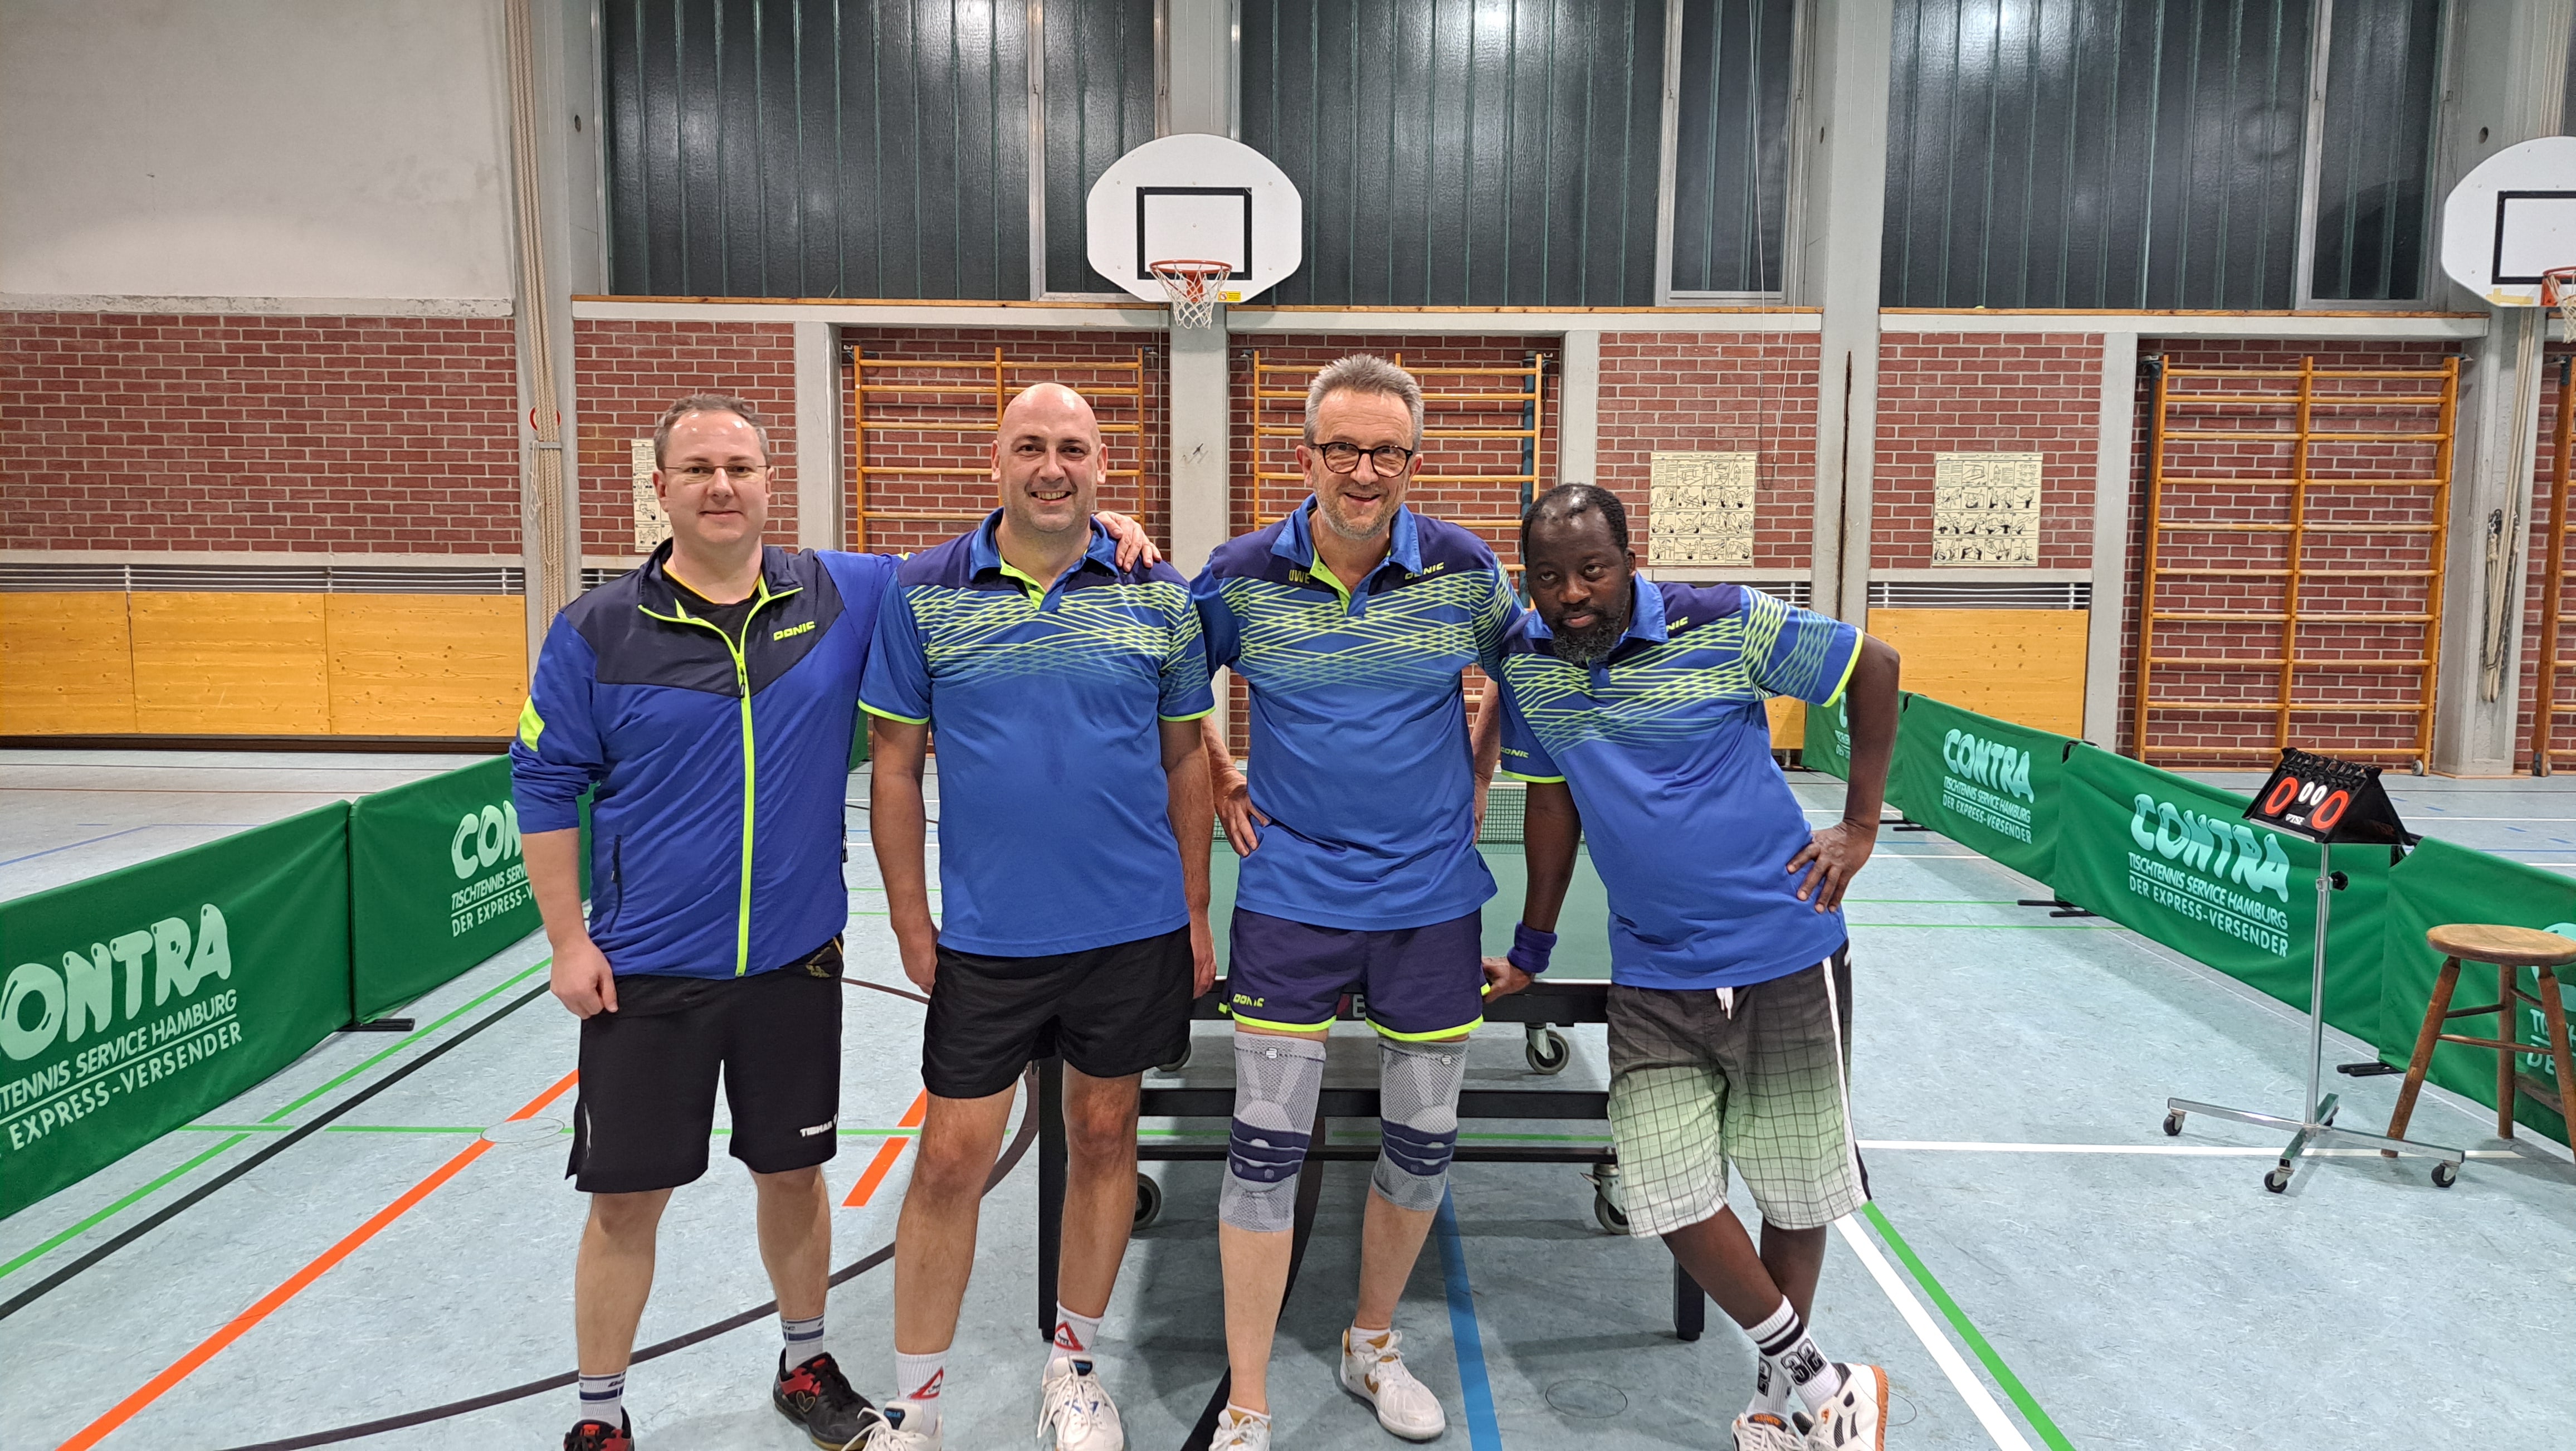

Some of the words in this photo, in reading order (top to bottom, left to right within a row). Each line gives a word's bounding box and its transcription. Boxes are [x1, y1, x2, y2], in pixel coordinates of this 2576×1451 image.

[1289, 569, 1310, 584] UWE
[773, 621, 815, 641] DONIC
[1666, 616, 1689, 632] NIC
[1943, 728, 2035, 804] CONTRA
[1943, 793, 1955, 807] DER
[1956, 800, 2032, 844] EXPRESS-VERSENDER
[1944, 776, 1977, 801] TISCHTENNIS
[1978, 790, 2000, 810] SERVICE
[1999, 799, 2031, 824] HAMBURG
[451, 800, 522, 879] CON
[2131, 793, 2290, 903] CONTRA
[451, 871, 505, 910] TISCHTENNIS
[506, 861, 529, 885] SERV
[452, 912, 474, 937] DER
[477, 884, 533, 925] EXPRESS-V
[2128, 851, 2185, 890] TISCHTENNIS
[2186, 875, 2227, 906] SERVICE
[2228, 891, 2288, 930] HAMBURG
[2129, 875, 2149, 898] DER
[2153, 885, 2289, 957] EXPRESS-VERSENDER
[0, 1060, 70, 1113] TENNIS
[76, 1026, 147, 1078] SERVICE
[151, 989, 237, 1045] HAMBURG
[8, 1021, 242, 1151] EXPRESS-VERSENDER
